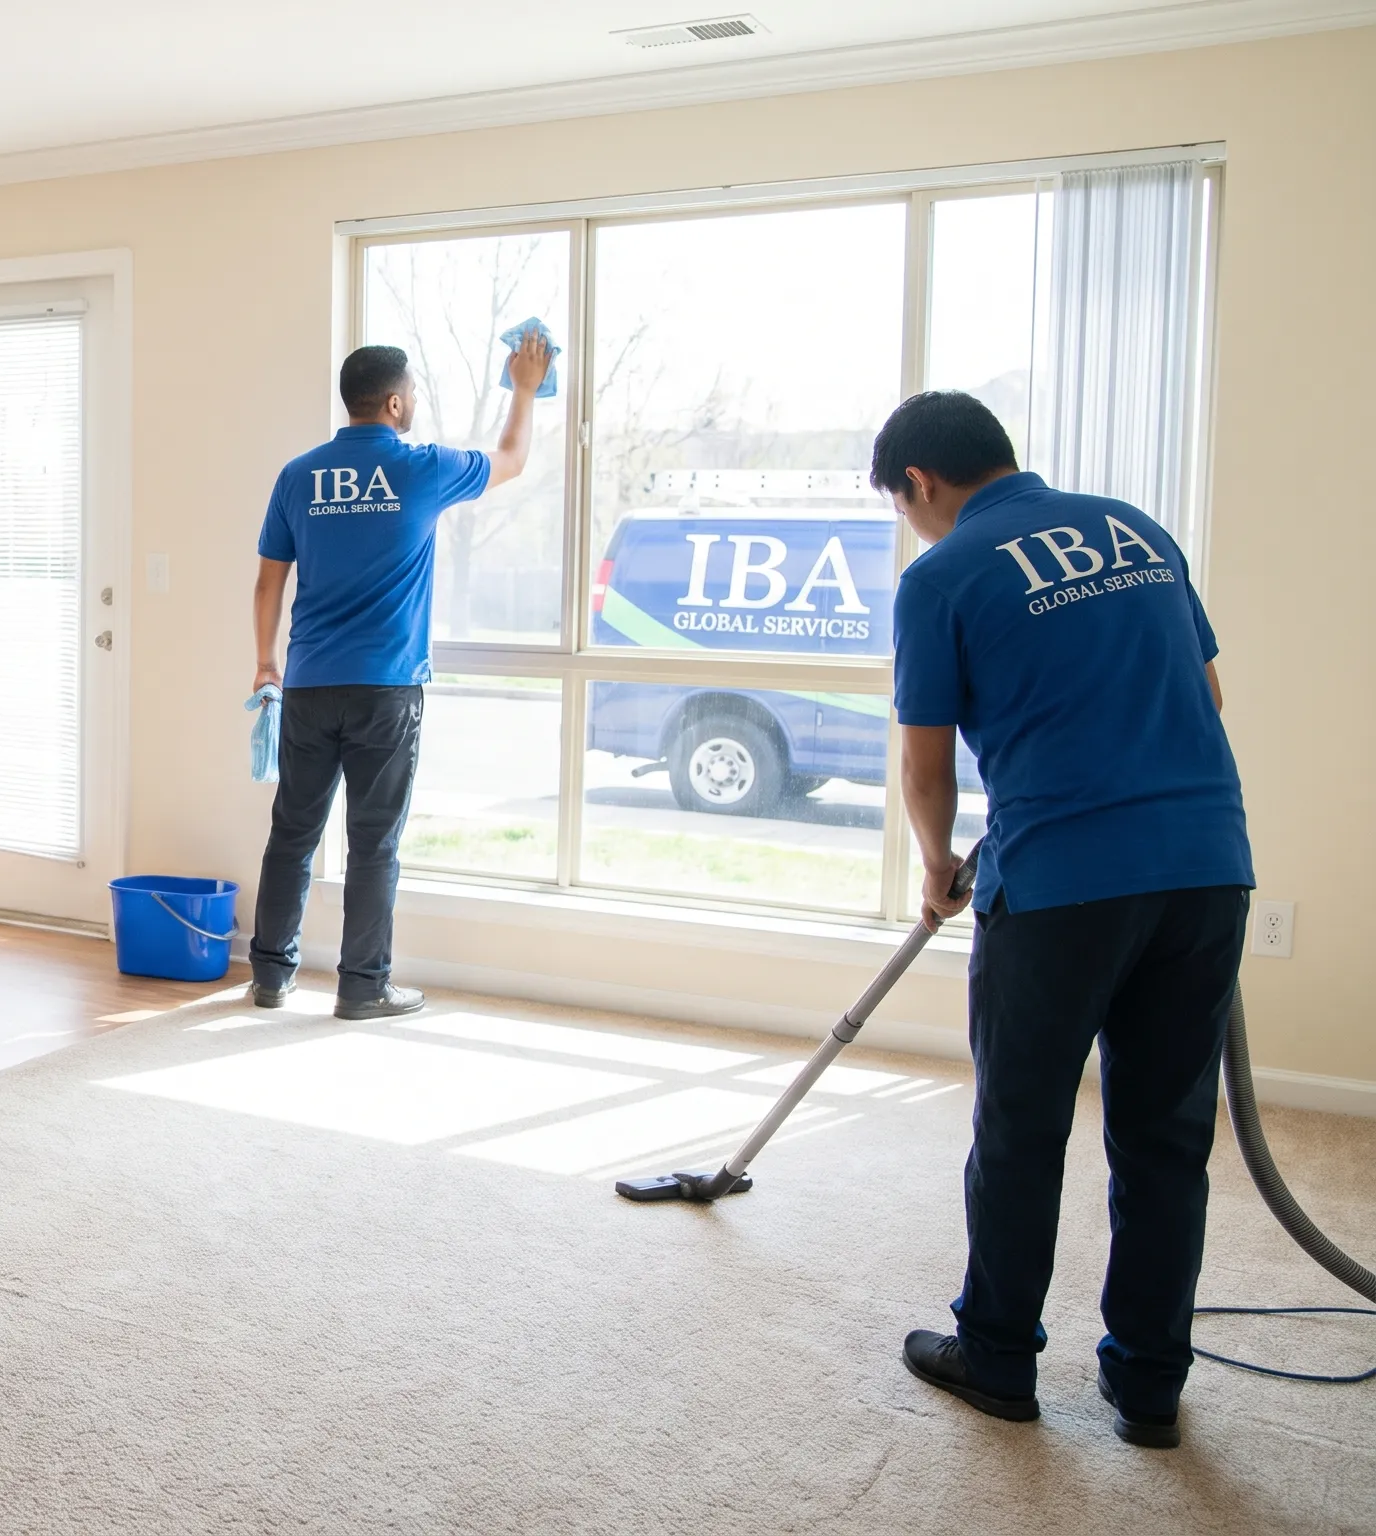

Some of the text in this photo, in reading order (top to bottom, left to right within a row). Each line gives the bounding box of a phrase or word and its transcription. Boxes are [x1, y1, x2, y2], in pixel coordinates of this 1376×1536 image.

[311, 465, 399, 504] IBA
[308, 503, 401, 516] GLOBAL SERVICES
[676, 533, 871, 614] IBA
[995, 514, 1165, 595] IBA
[1028, 568, 1175, 615] GLOBAL SERVICES
[673, 611, 870, 639] GLOBAL SERVICES
